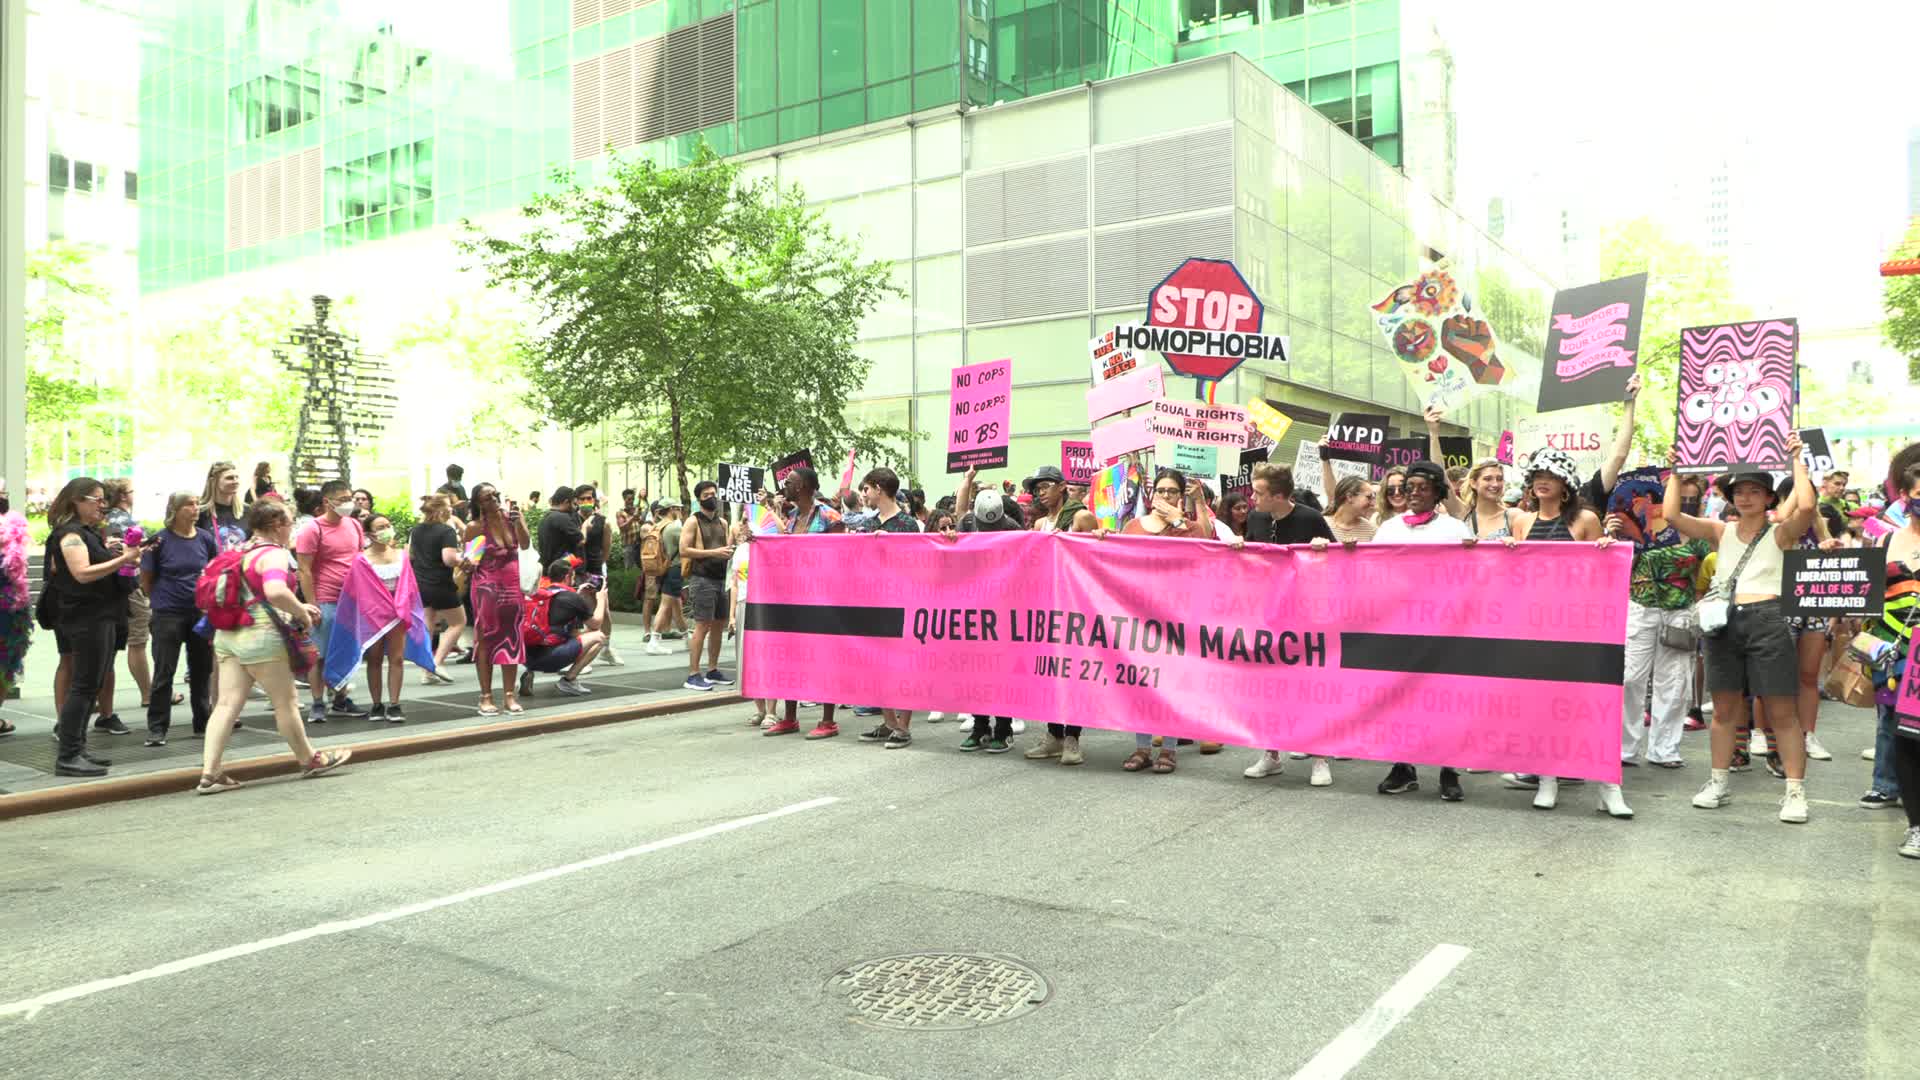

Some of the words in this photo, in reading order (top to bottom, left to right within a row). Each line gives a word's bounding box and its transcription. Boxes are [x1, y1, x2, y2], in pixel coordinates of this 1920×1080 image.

[1155, 285, 1253, 332] STOP
[1571, 307, 1619, 330] SUPPORT
[1115, 325, 1286, 361] HOMOPHOBIA
[1563, 340, 1590, 352] YOUR
[1592, 328, 1624, 341] LOCAL
[1560, 363, 1577, 373] SEX
[1578, 350, 1620, 367] WORKER
[957, 373, 970, 388] NO
[978, 367, 1005, 384] COPS
[956, 401, 970, 416] NO
[974, 395, 1006, 412] CORPS
[1155, 402, 1191, 417] EQUAL
[1196, 409, 1245, 422] RIGHTS
[1685, 386, 1783, 427] GOOD
[954, 429, 968, 444] NO
[976, 422, 999, 444] BS
[1153, 424, 1192, 439] HUMAN
[1197, 432, 1245, 444] RIGHTS
[1328, 425, 1383, 445] NYPD
[1546, 433, 1600, 451] KILLS
[729, 465, 750, 480] WE
[1226, 477, 1251, 489] STOL
[727, 477, 752, 492] ARE
[1806, 559, 1820, 569] WE
[1821, 559, 1839, 569] ARE
[1841, 558, 1859, 568] NOT
[1796, 571, 1841, 582] LIBERATED
[1843, 571, 1869, 582] UNTIL
[1810, 584, 1826, 594] ALL
[1827, 584, 1840, 594] OF
[1841, 584, 1854, 594] US
[1799, 597, 1817, 607] ARE
[1818, 597, 1866, 607] LIBERATED
[1401, 600, 1503, 625] TRANS
[1527, 602, 1617, 630] QUEER
[913, 608, 998, 645] QUEER
[1010, 609, 1185, 655] LIBERATION
[1200, 625, 1325, 667] MARCH
[1035, 656, 1071, 679] JUNE
[1079, 659, 1107, 686] 27,
[1116, 664, 1160, 689] 2021
[1552, 696, 1612, 724] GAY
[1461, 729, 1614, 767] ASEXUAL
